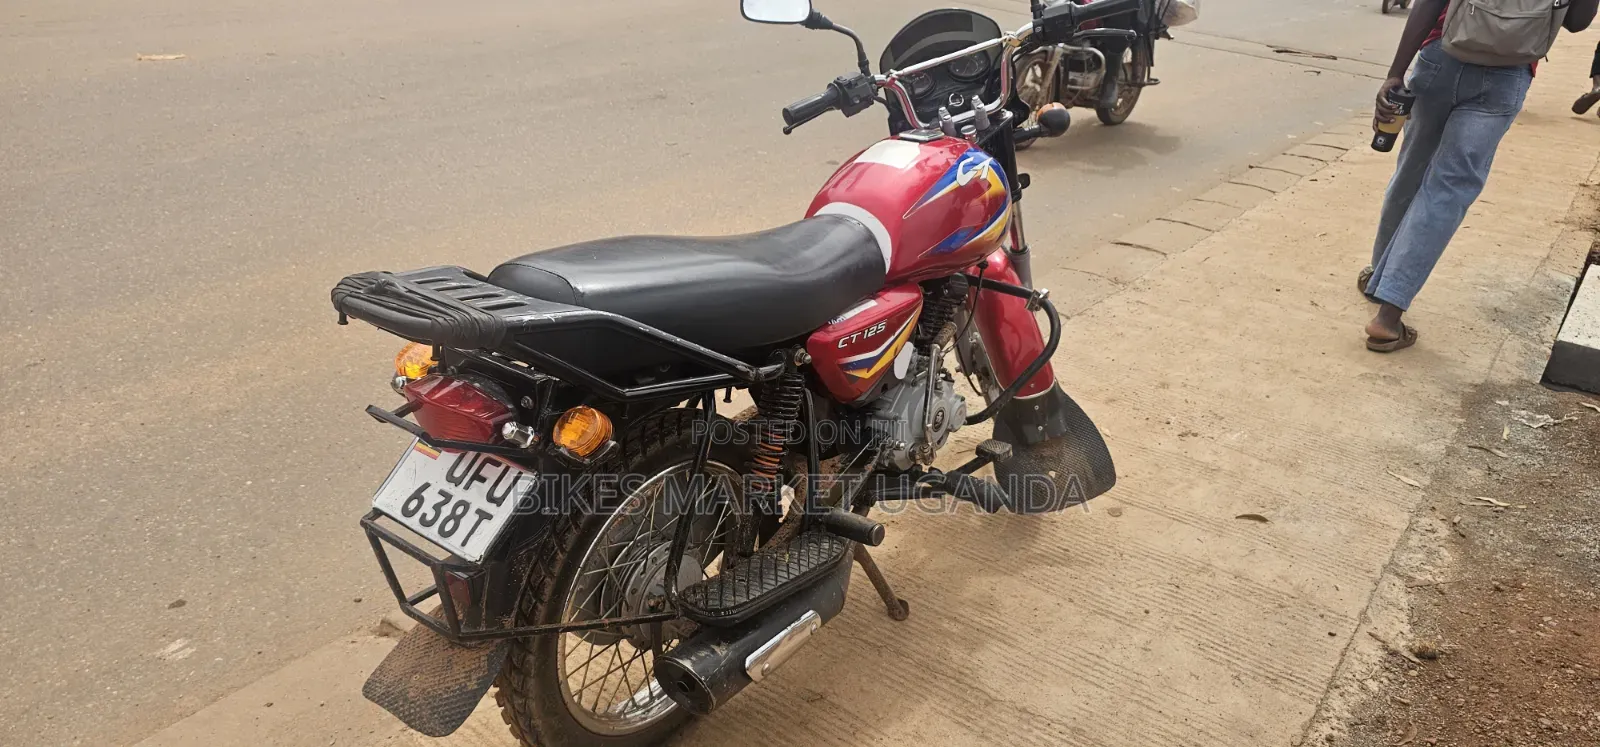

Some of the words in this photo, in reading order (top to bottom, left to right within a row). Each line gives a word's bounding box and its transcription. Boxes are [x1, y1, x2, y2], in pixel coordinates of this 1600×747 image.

[837, 332, 862, 349] CT
[863, 321, 887, 340] 125
[445, 451, 524, 508] UFU
[401, 481, 494, 547] 638T
